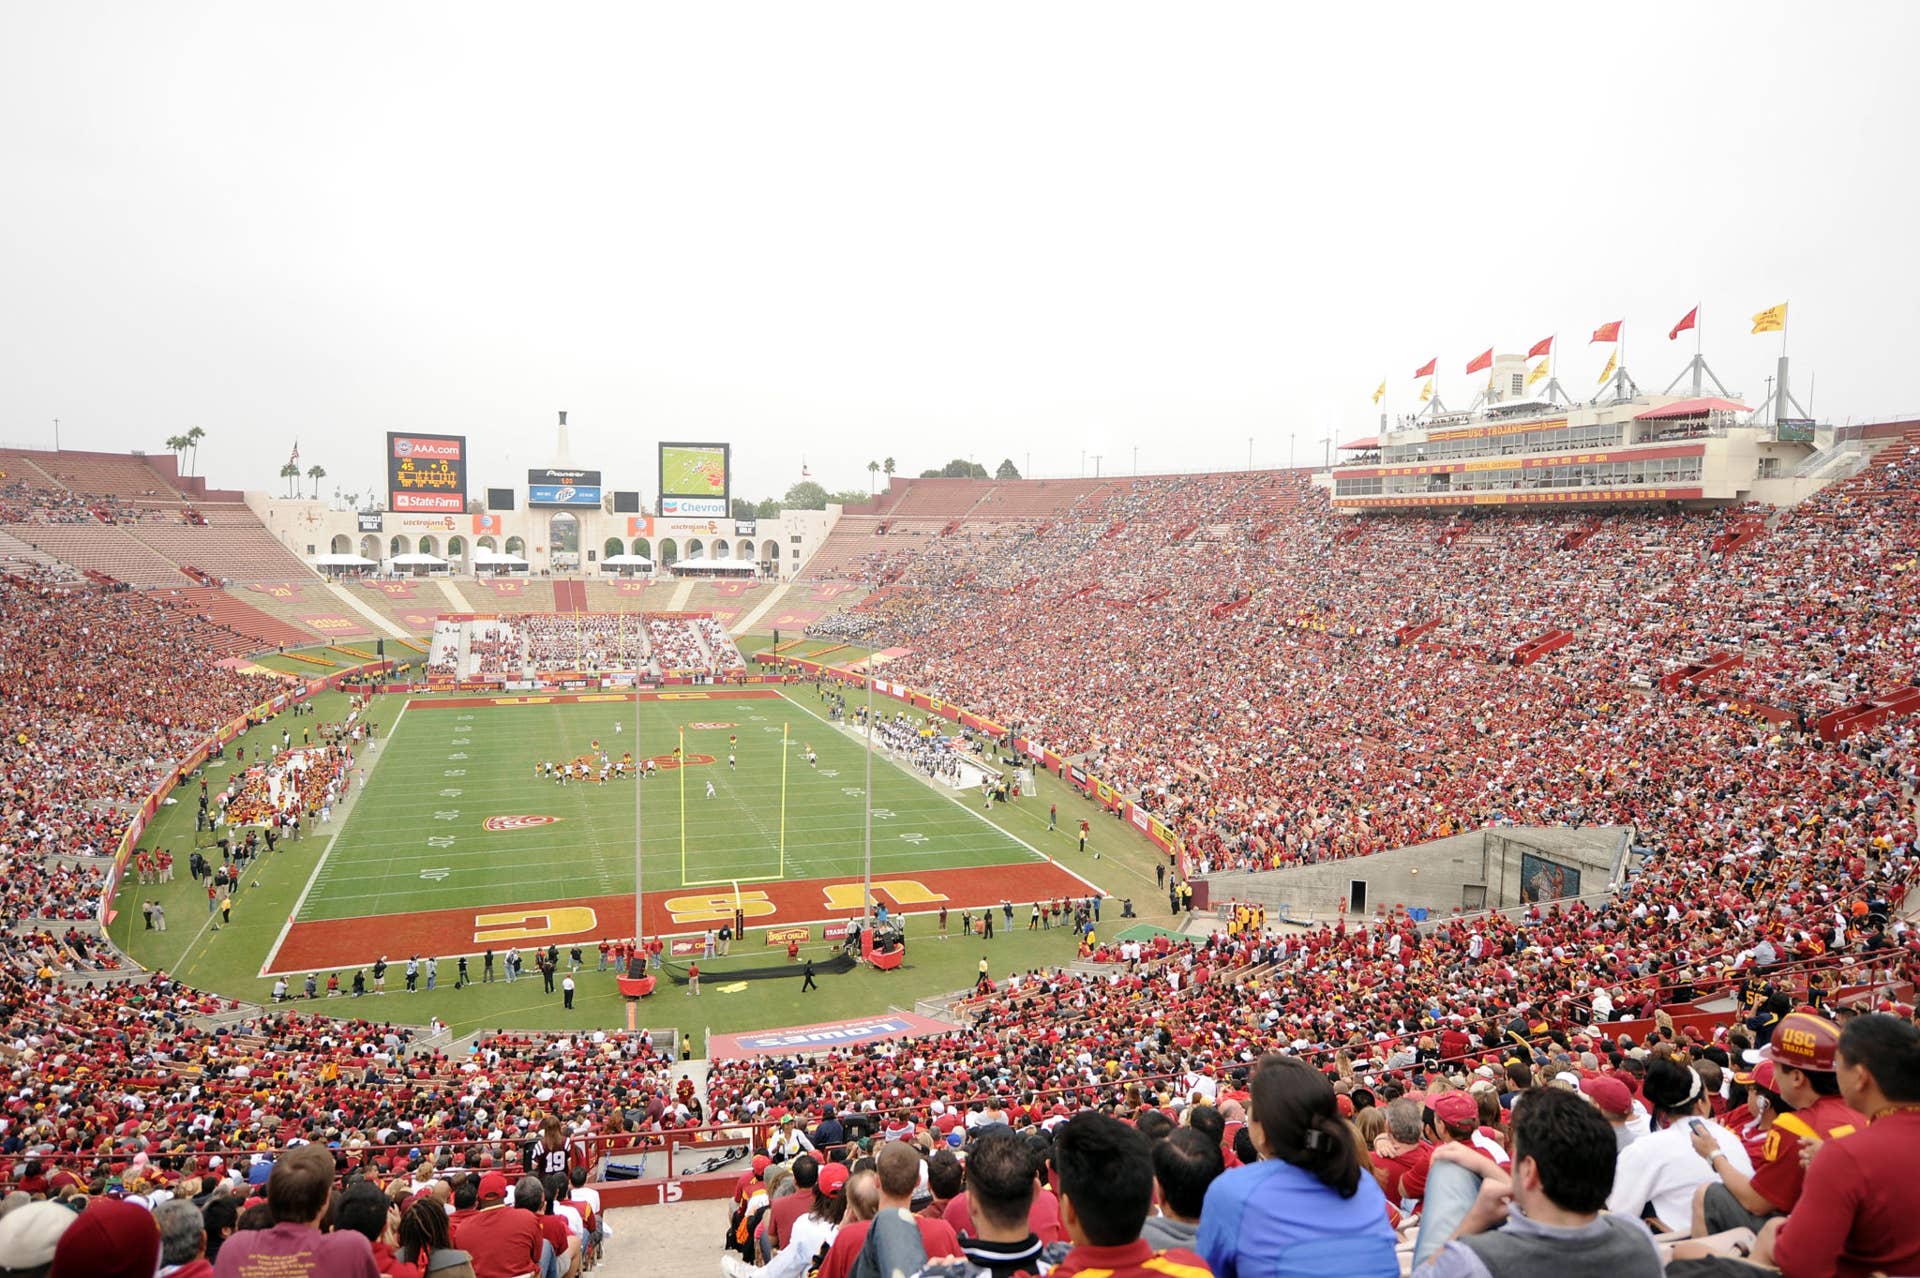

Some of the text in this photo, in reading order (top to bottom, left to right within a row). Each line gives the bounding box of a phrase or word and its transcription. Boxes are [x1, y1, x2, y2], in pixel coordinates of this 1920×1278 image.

[414, 444, 459, 454] AAA.com
[401, 463, 414, 471] 45
[410, 496, 459, 507] State Farm
[681, 502, 725, 512] Chevron
[384, 584, 404, 593] 32
[499, 583, 516, 591] 12
[754, 1022, 897, 1047] LOWE'S
[1782, 1028, 1817, 1048] USC
[1783, 1043, 1815, 1057] TROJANS
[544, 1150, 566, 1173] 19
[657, 1181, 683, 1204] 15
